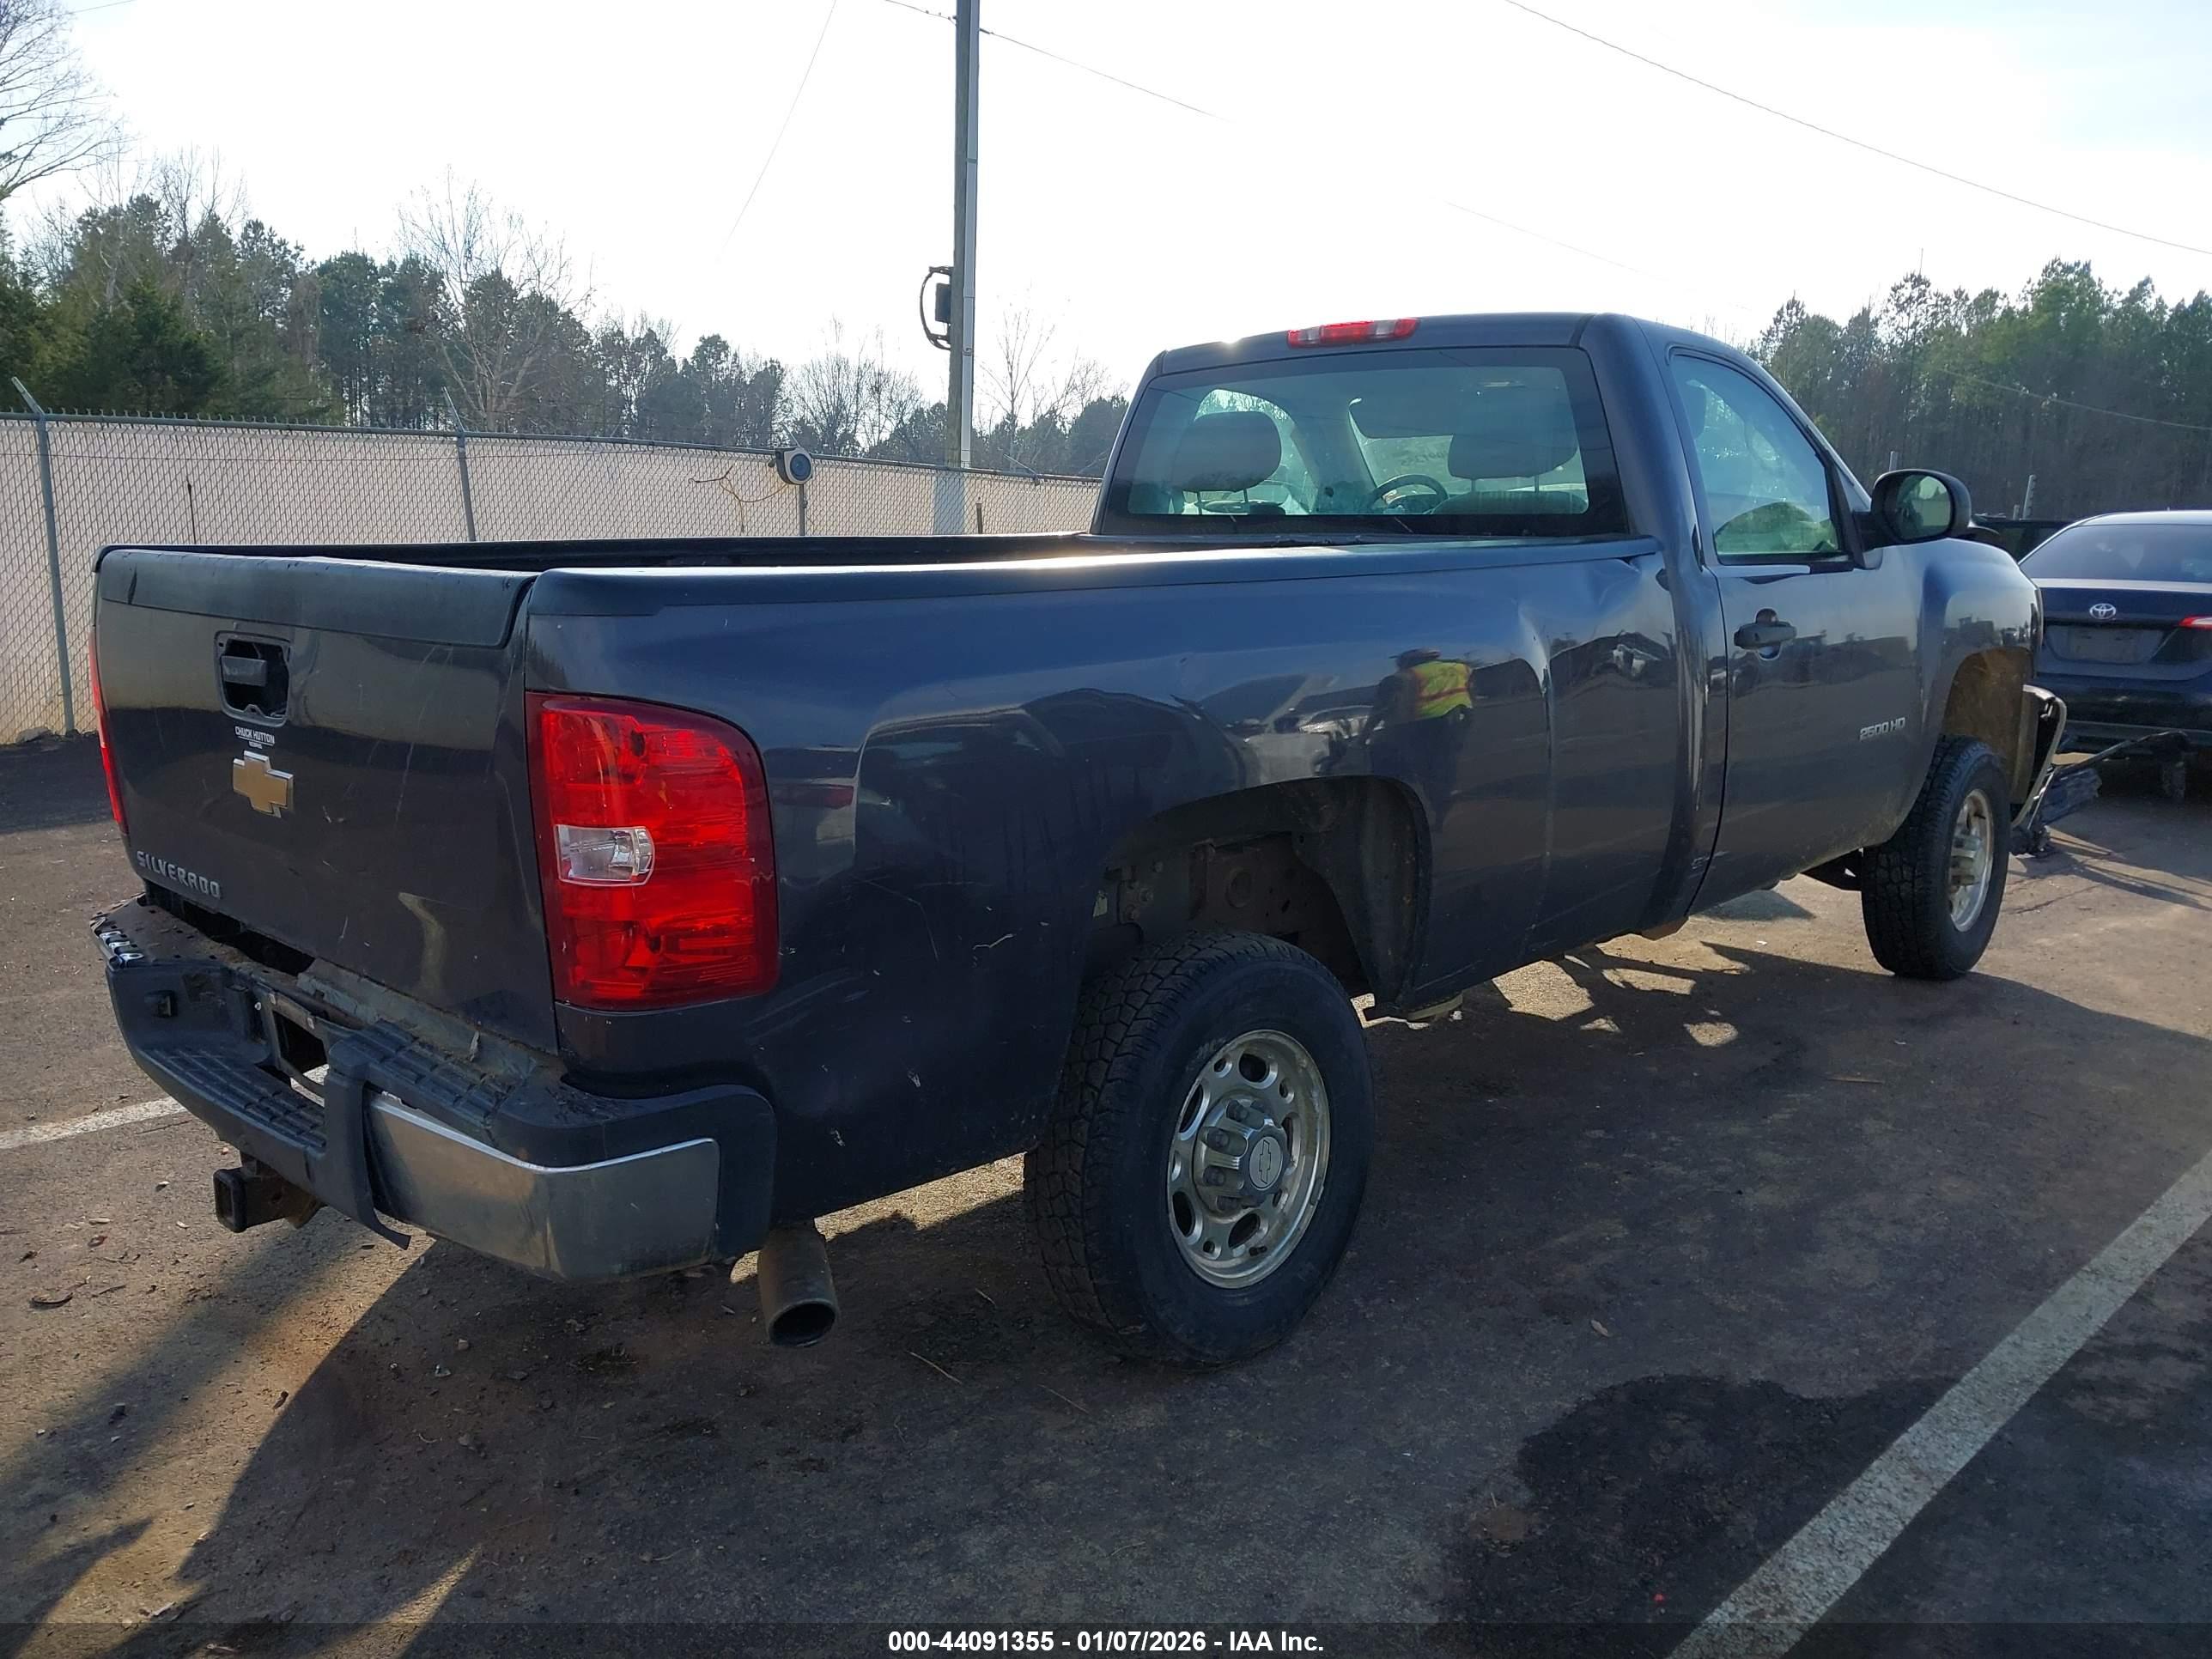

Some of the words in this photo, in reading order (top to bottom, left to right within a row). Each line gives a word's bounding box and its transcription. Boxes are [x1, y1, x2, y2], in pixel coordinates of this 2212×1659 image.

[234, 726, 253, 738] CHUCK
[252, 729, 276, 744] HUTTON
[137, 850, 221, 899] SILVERADO
